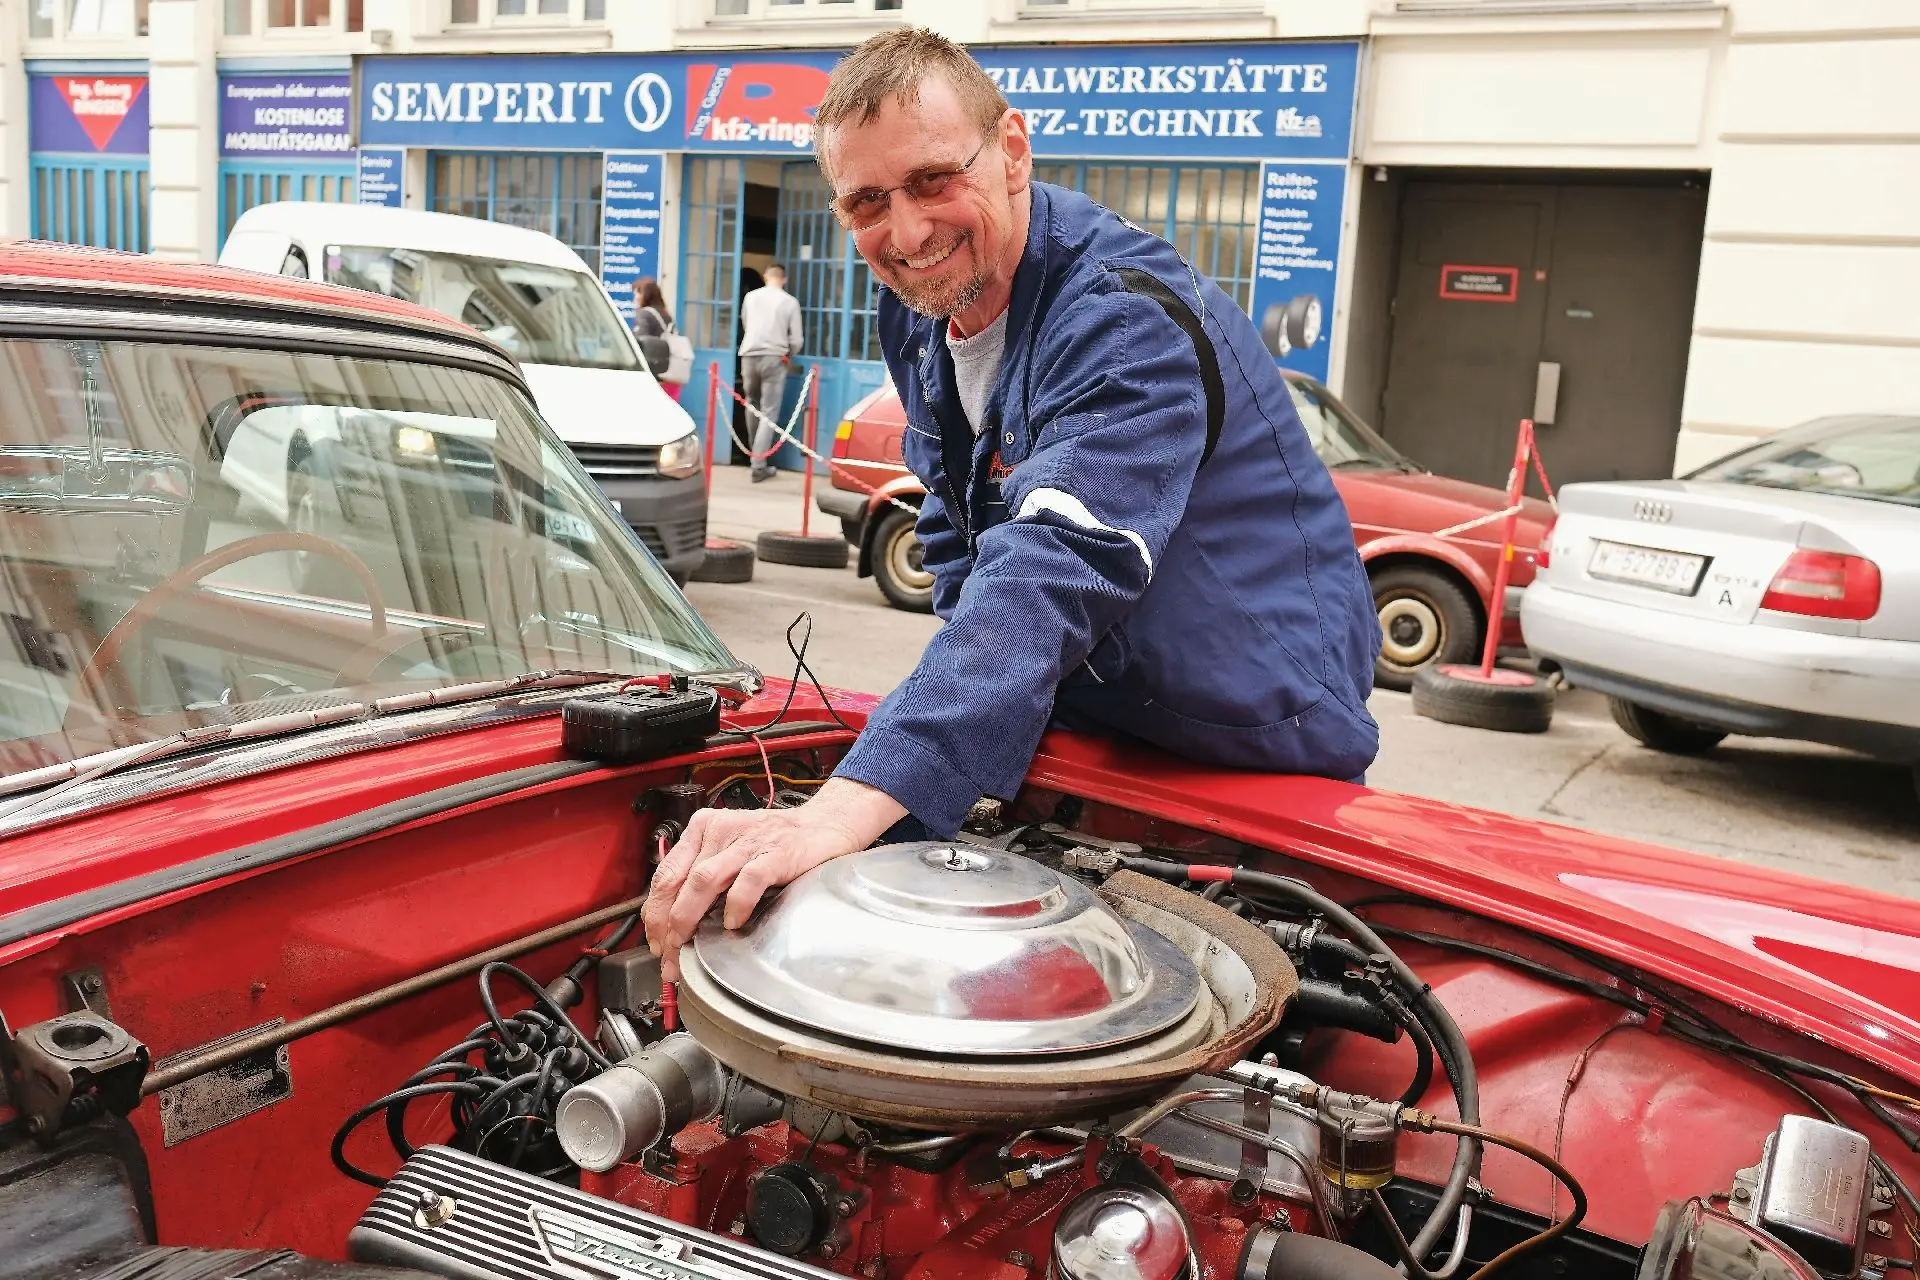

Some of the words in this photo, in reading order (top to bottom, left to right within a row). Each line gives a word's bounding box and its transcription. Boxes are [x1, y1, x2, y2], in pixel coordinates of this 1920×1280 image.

[702, 67, 732, 109] Georg
[371, 82, 612, 123] SEMPERIT
[254, 107, 345, 126] KOSTENLOSE
[607, 161, 649, 174] Oldtimer
[1267, 172, 1318, 187] Reifen-
[1265, 187, 1317, 200] service
[1718, 590, 1733, 606] A
[575, 1238, 691, 1280] Thunder
